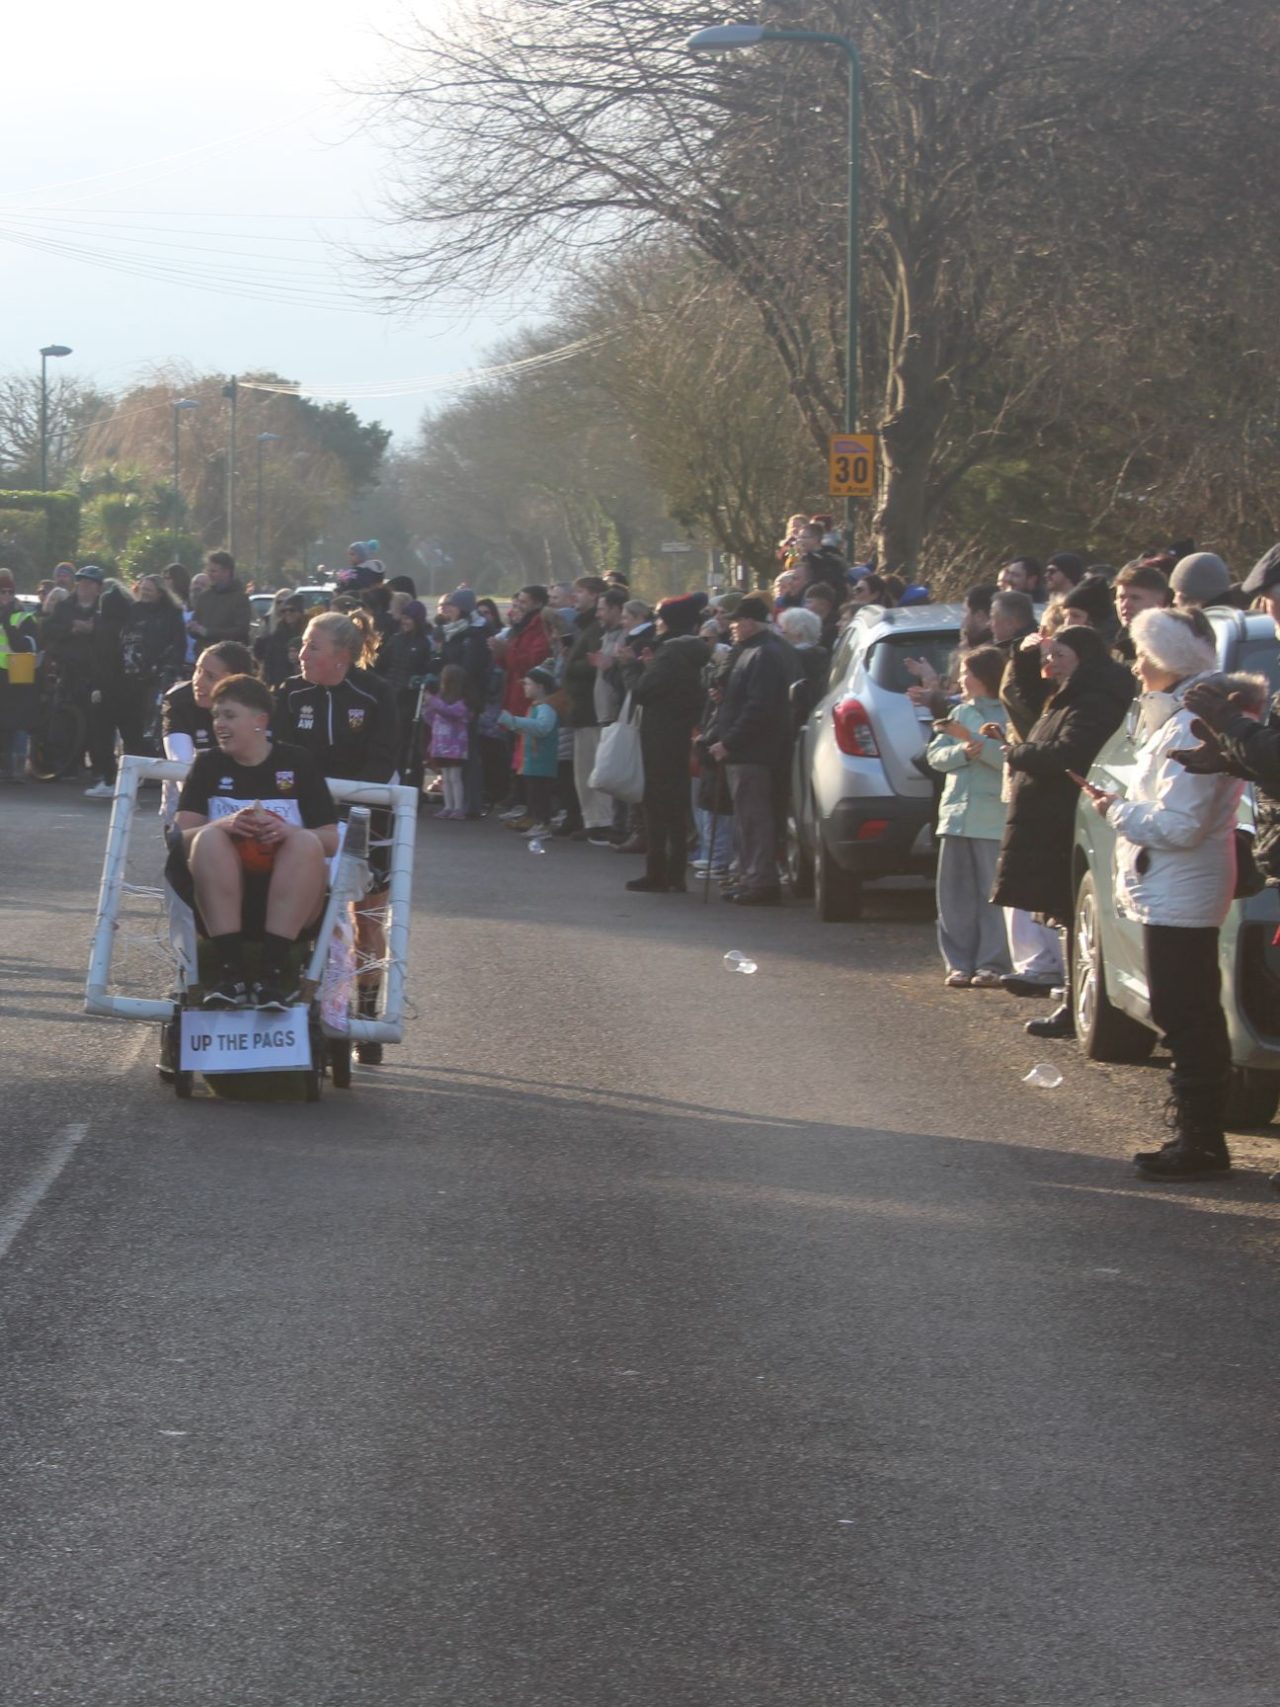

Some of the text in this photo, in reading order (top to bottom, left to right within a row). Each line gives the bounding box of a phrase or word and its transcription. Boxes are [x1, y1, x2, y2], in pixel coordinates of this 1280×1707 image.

[835, 456, 868, 484] 30
[297, 718, 314, 729] AW
[190, 1030, 295, 1051] UP THE PAGS
